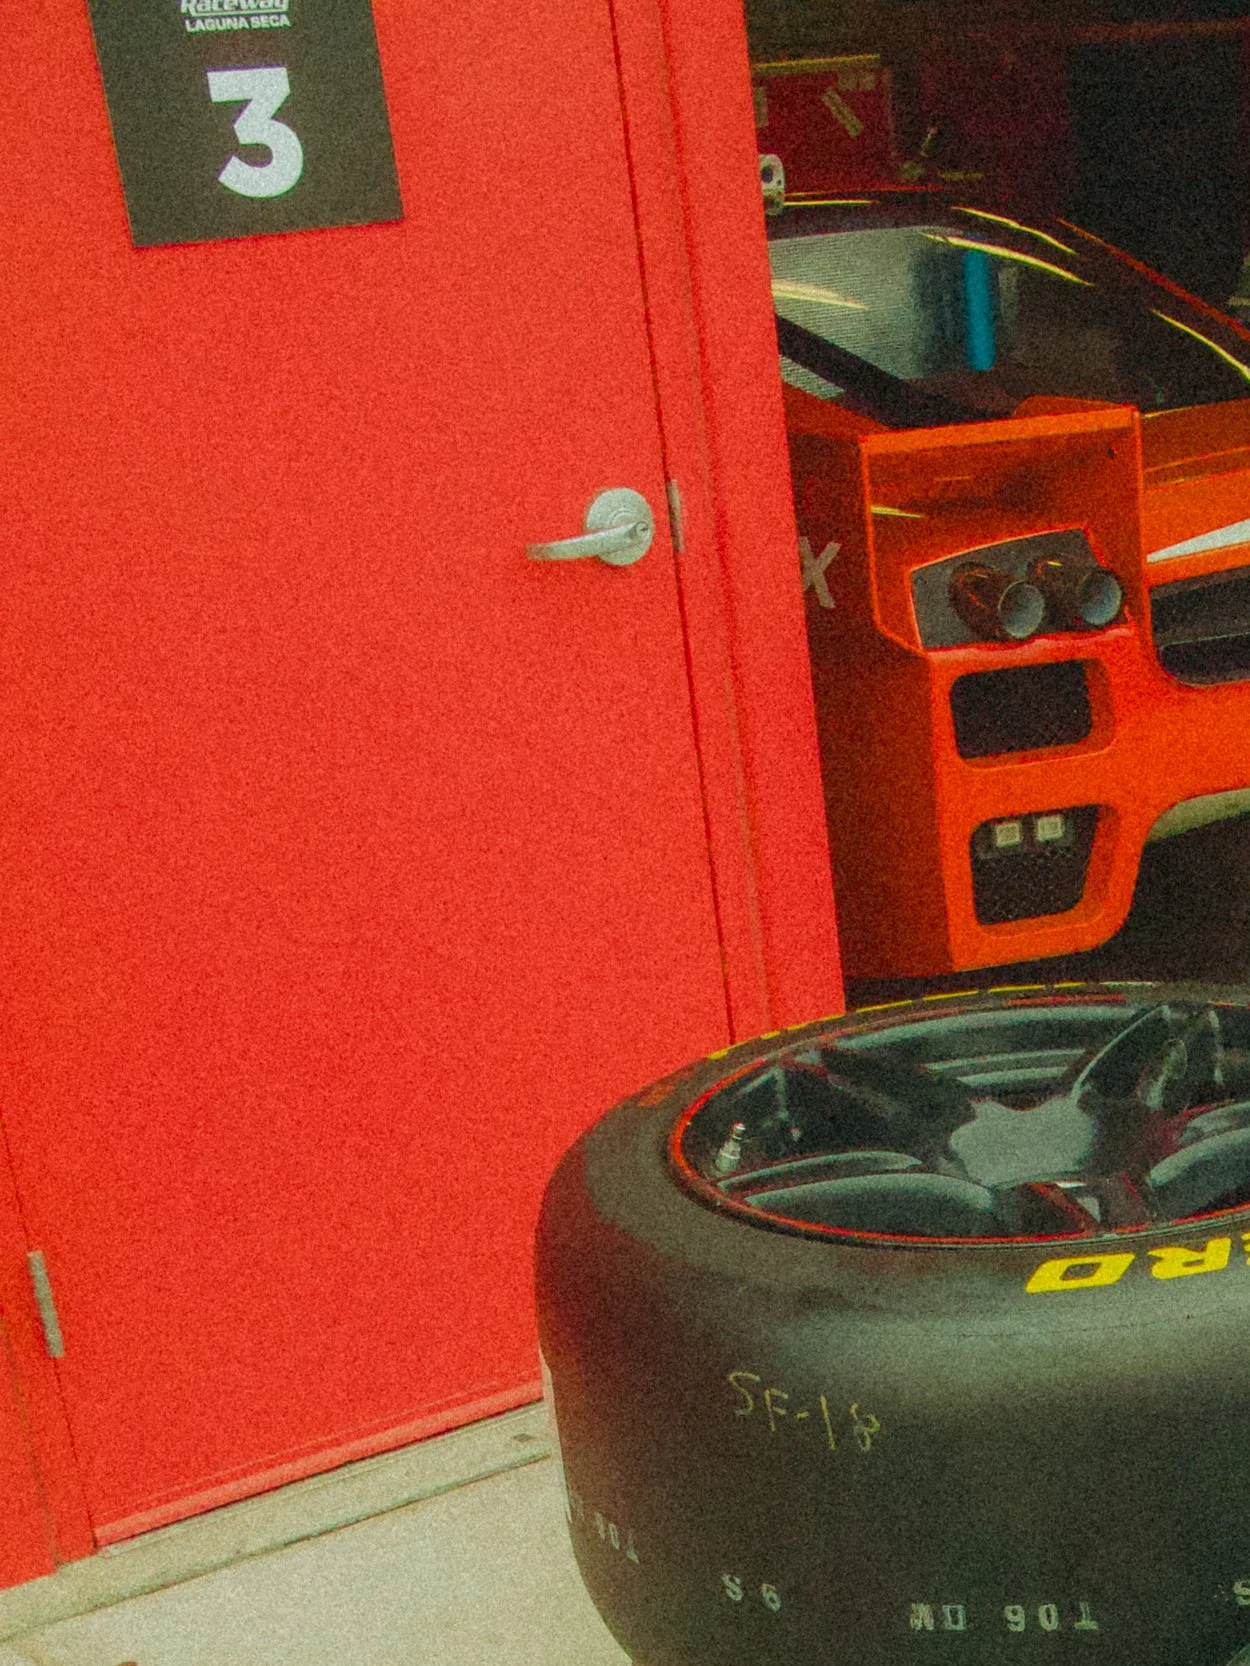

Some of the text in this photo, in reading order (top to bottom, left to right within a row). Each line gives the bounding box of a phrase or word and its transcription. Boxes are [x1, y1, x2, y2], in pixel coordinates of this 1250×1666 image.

[184, 14, 292, 32] LAGUNA SECA
[206, 66, 303, 198] 3
